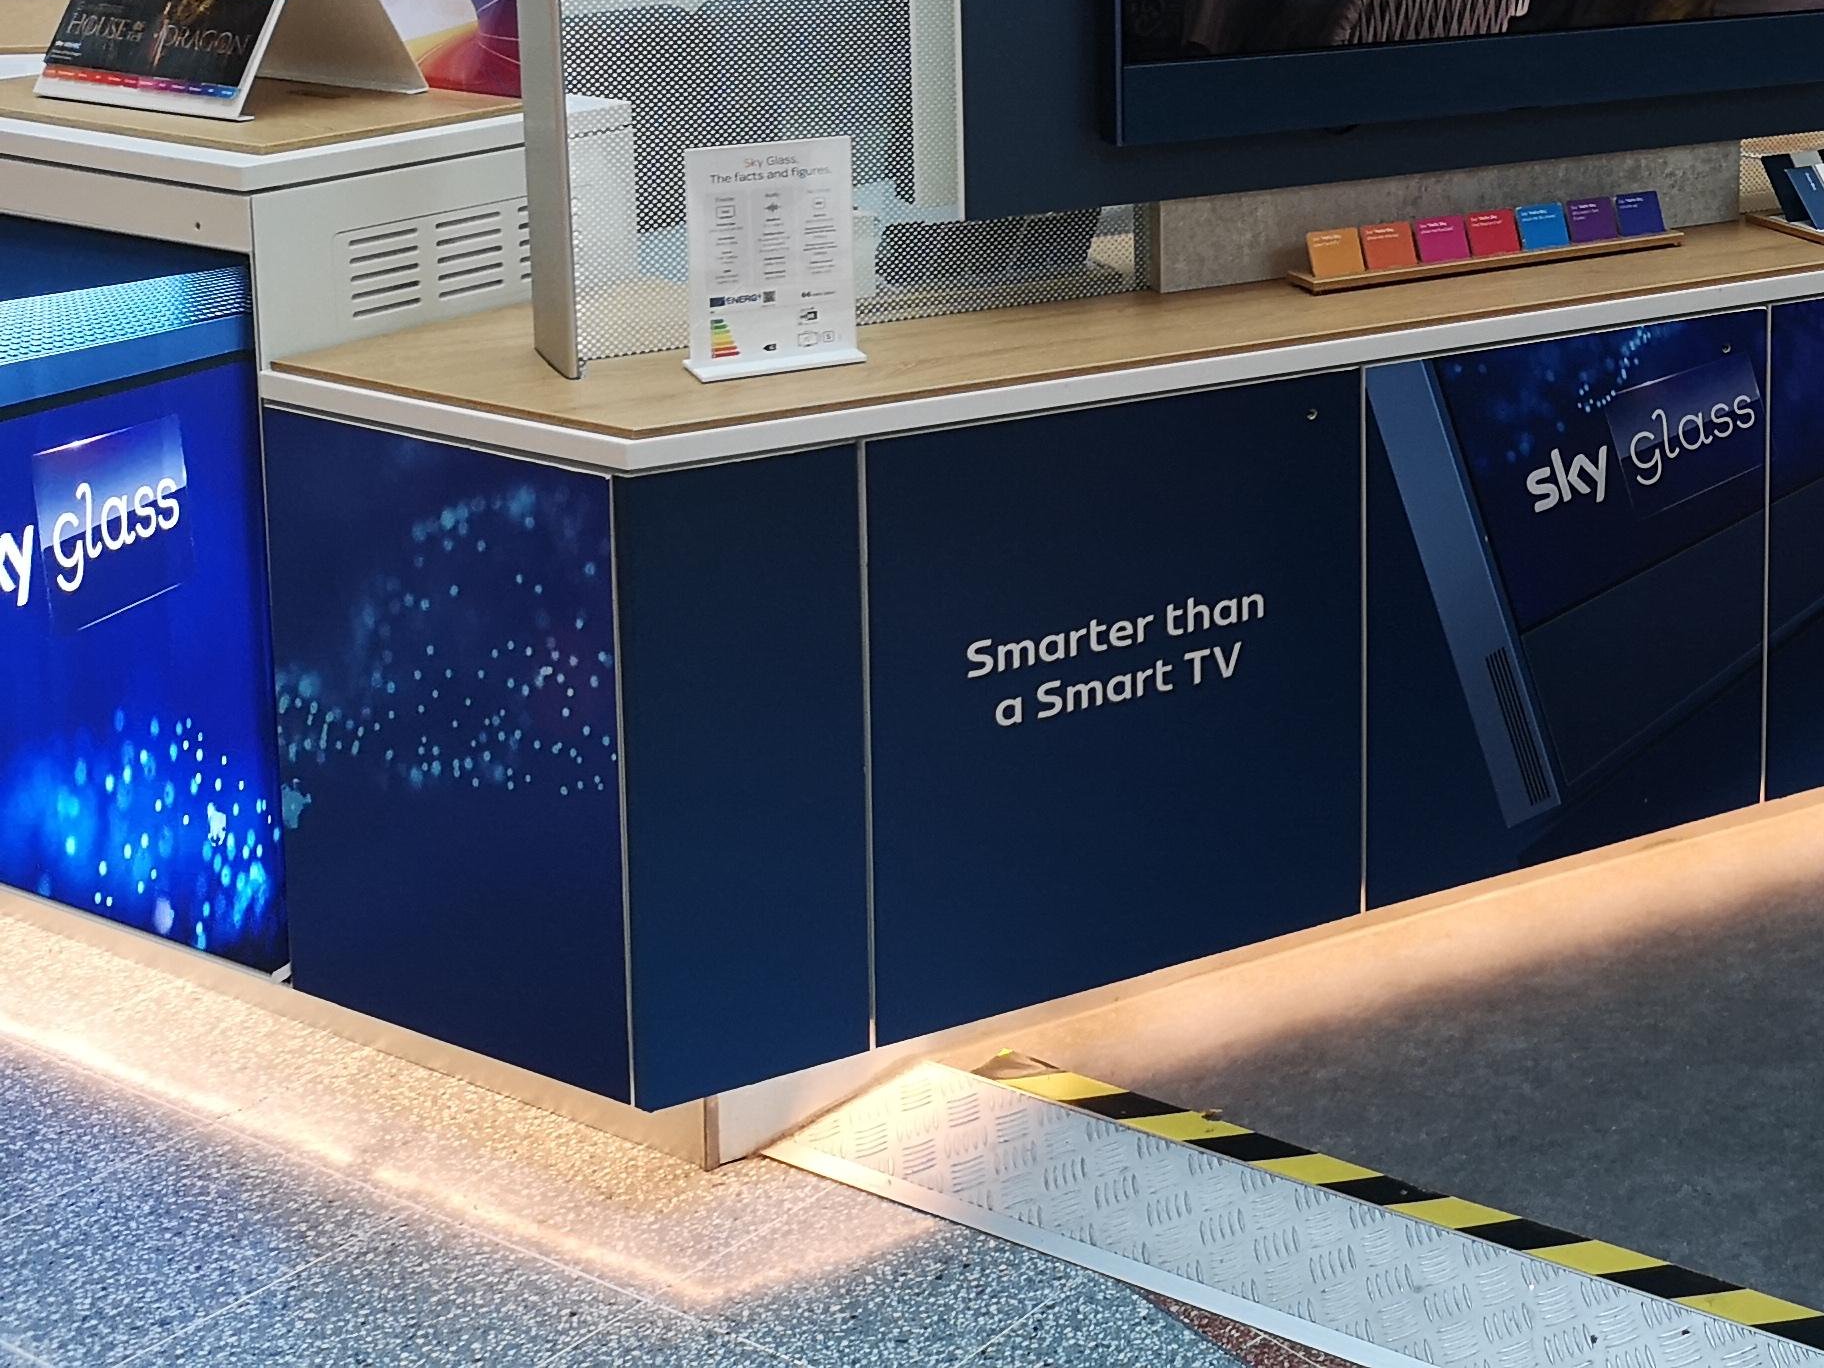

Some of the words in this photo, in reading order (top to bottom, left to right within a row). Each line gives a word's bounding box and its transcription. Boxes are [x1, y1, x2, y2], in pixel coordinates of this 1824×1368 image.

[66, 11, 130, 41] HOUSE
[164, 23, 250, 56] DRAGON
[709, 173, 732, 184] The
[733, 171, 764, 183] facts
[766, 168, 789, 181] and
[743, 158, 763, 170] Sky
[1526, 445, 1608, 513] sky
[1629, 394, 1756, 486] glass
[52, 477, 181, 592] glass
[966, 614, 1155, 679] Smarter
[1165, 592, 1266, 637] than
[995, 695, 1023, 727] a
[1036, 659, 1174, 720] Smart
[1183, 641, 1243, 685] TV
